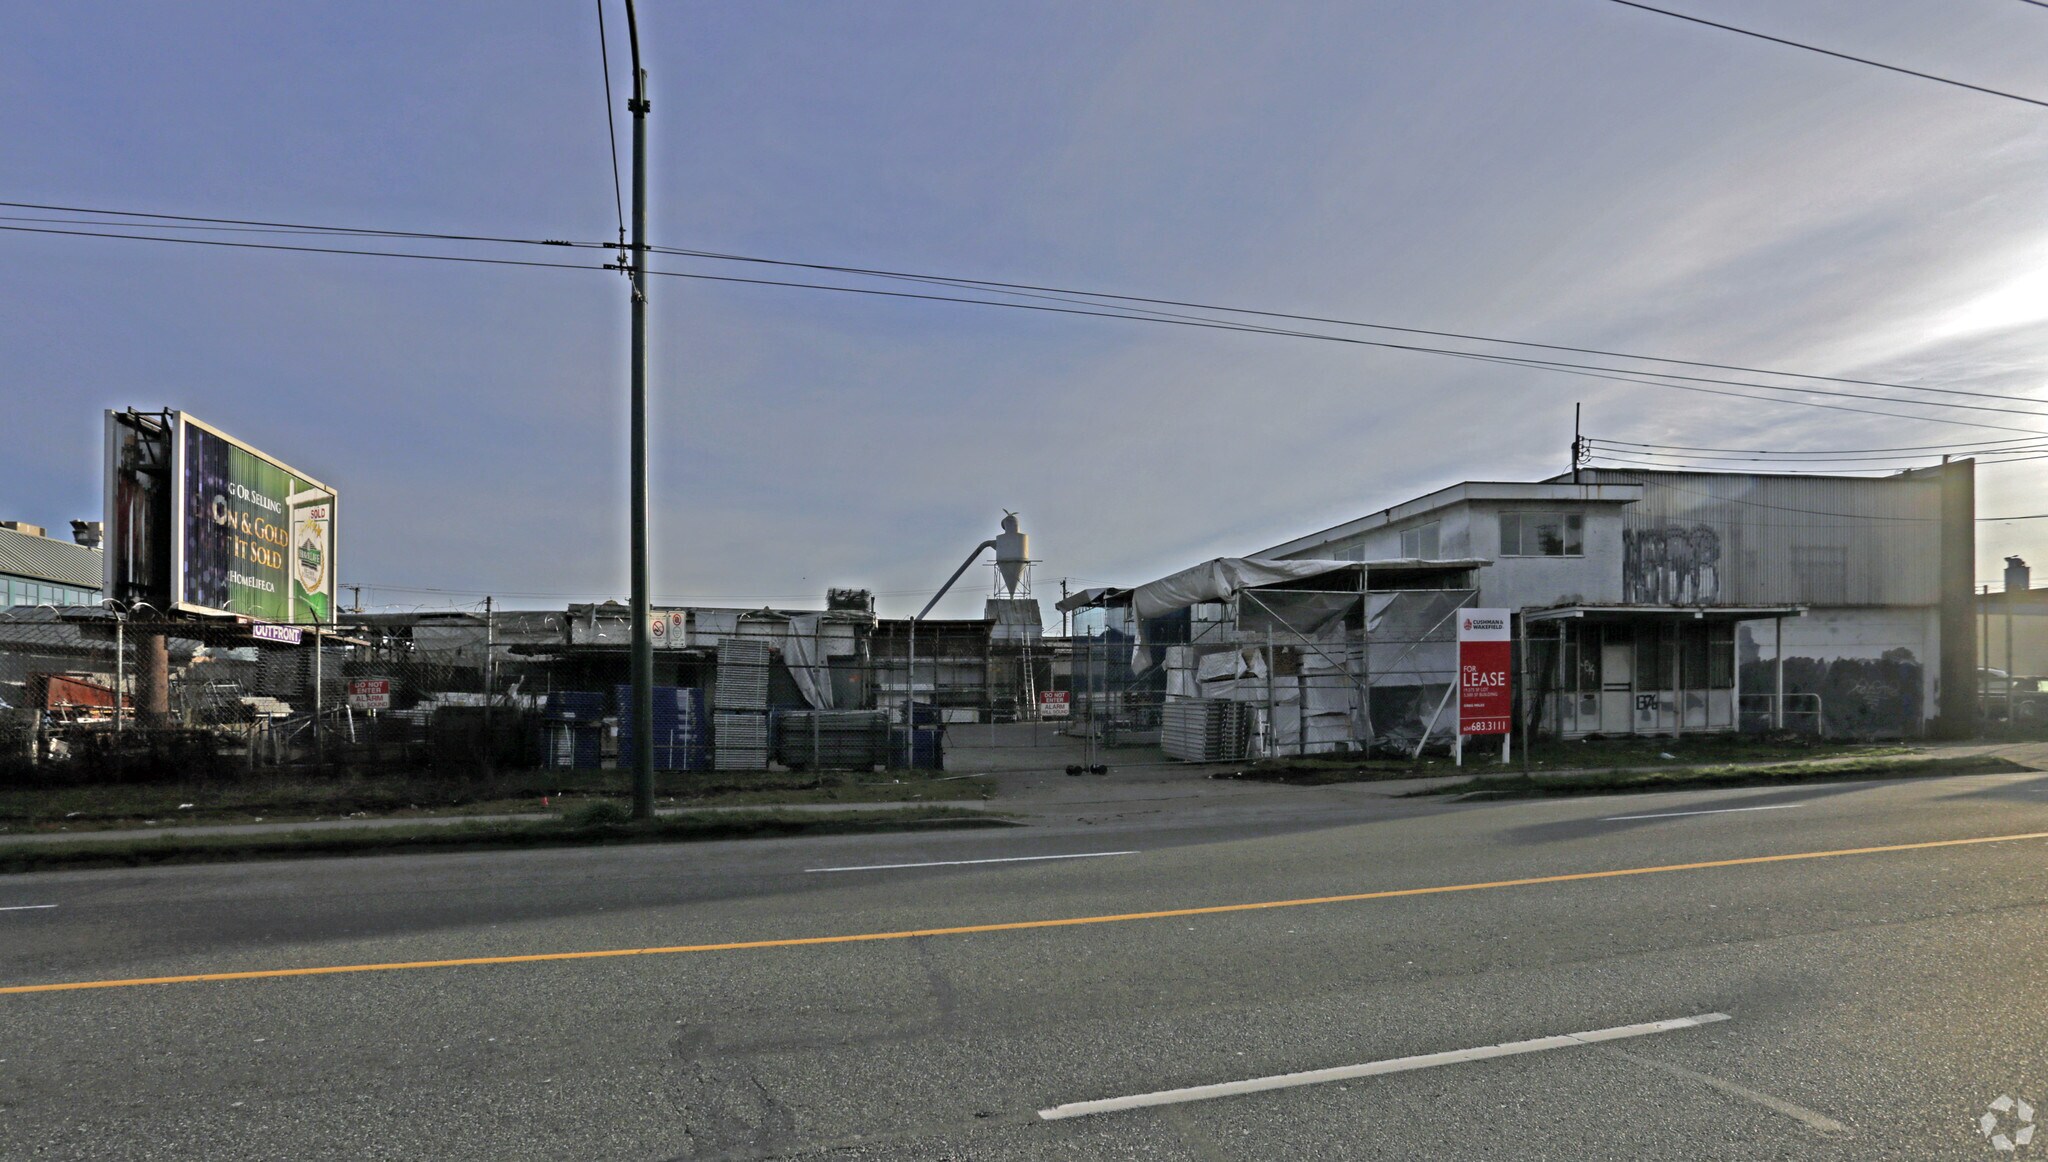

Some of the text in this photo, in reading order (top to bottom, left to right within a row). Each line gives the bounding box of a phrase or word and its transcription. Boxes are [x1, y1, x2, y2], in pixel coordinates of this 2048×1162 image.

[310, 508, 326, 519] SOLD
[241, 512, 253, 535] &
[254, 517, 289, 548] GOLD
[234, 535, 282, 569] IT SOLD
[255, 624, 299, 642] OUTFRONT
[1463, 672, 1505, 687] LEASE
